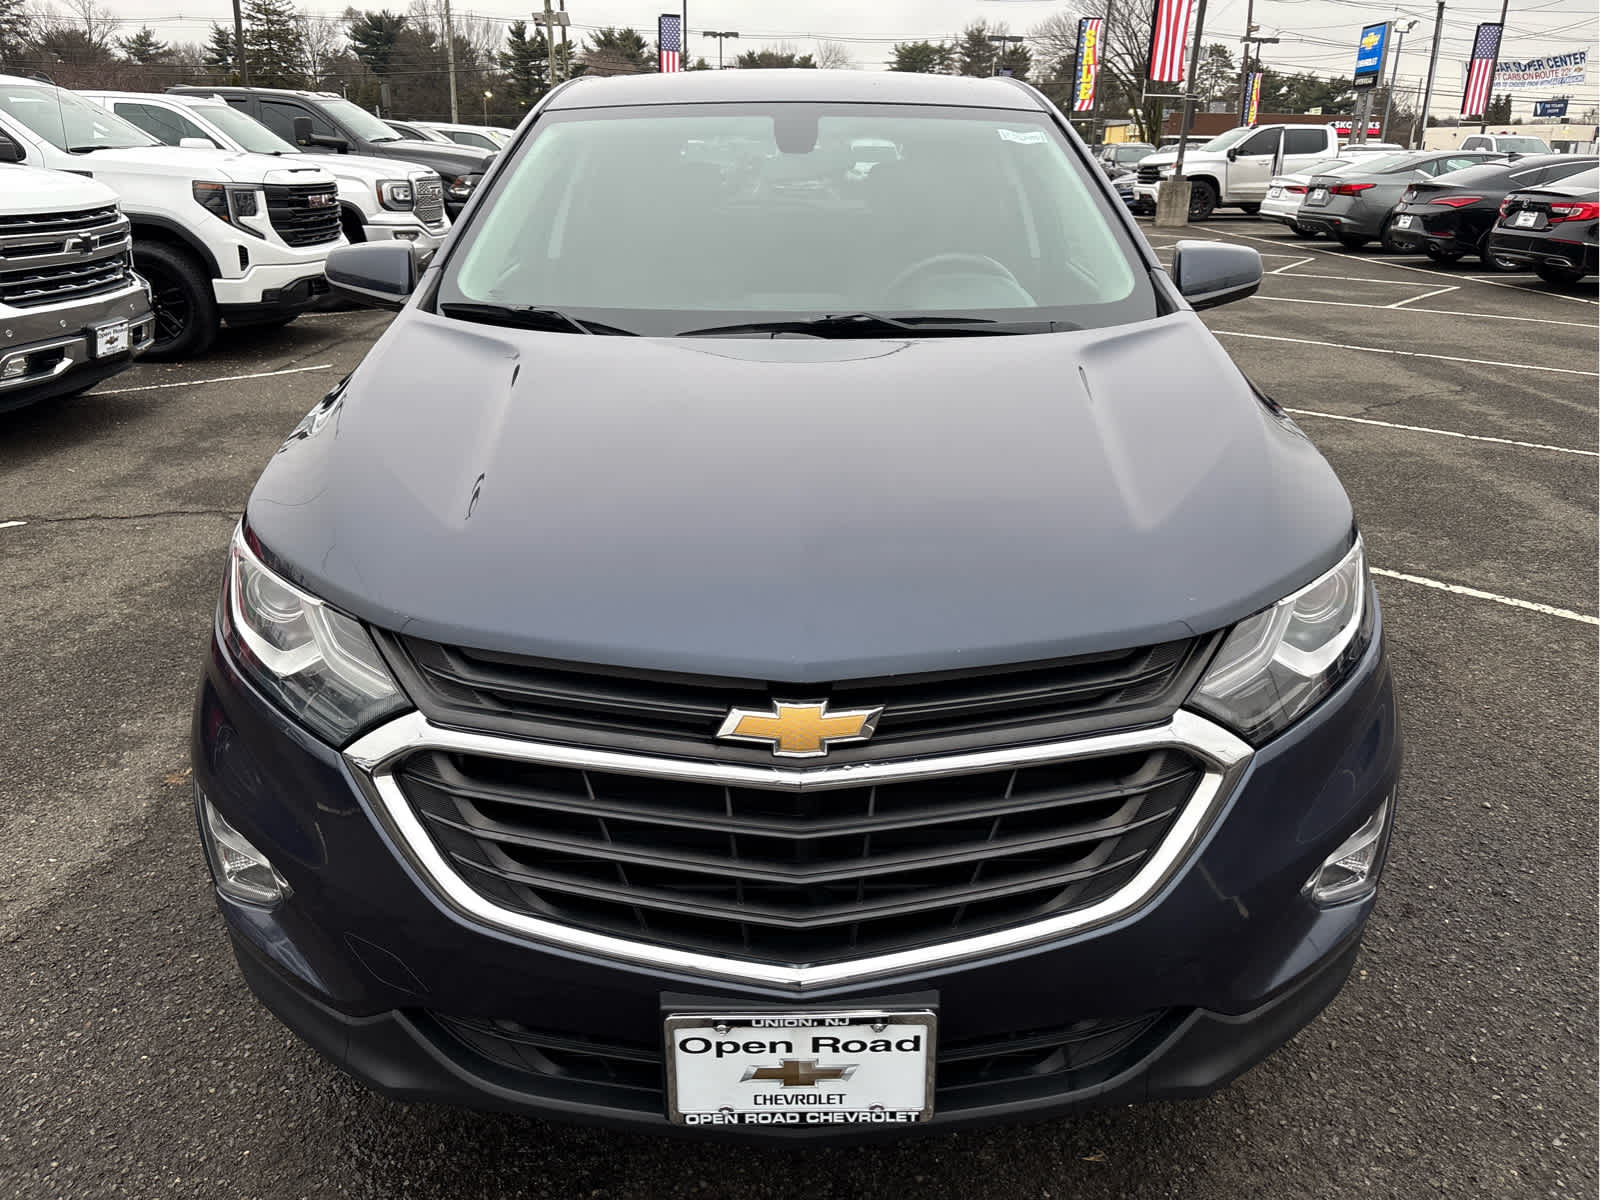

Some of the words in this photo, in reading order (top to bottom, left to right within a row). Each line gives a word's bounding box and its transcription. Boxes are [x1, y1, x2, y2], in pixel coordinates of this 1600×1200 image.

[1079, 29, 1096, 100] SALE
[1513, 59, 1545, 73] SUPER
[1546, 51, 1586, 69] CENTER
[1502, 73, 1521, 81] CARS
[1522, 72, 1534, 81] ON
[1534, 68, 1560, 80] ROUTE
[751, 1018, 818, 1029] UNION,
[824, 1017, 850, 1027] NJ
[678, 1036, 793, 1058] Open
[811, 1035, 921, 1054] Road
[753, 1093, 847, 1106] CHEVROLET
[685, 1113, 739, 1125] OPEN
[744, 1112, 800, 1124] ROAD
[805, 1111, 920, 1124] CHEVROLET
